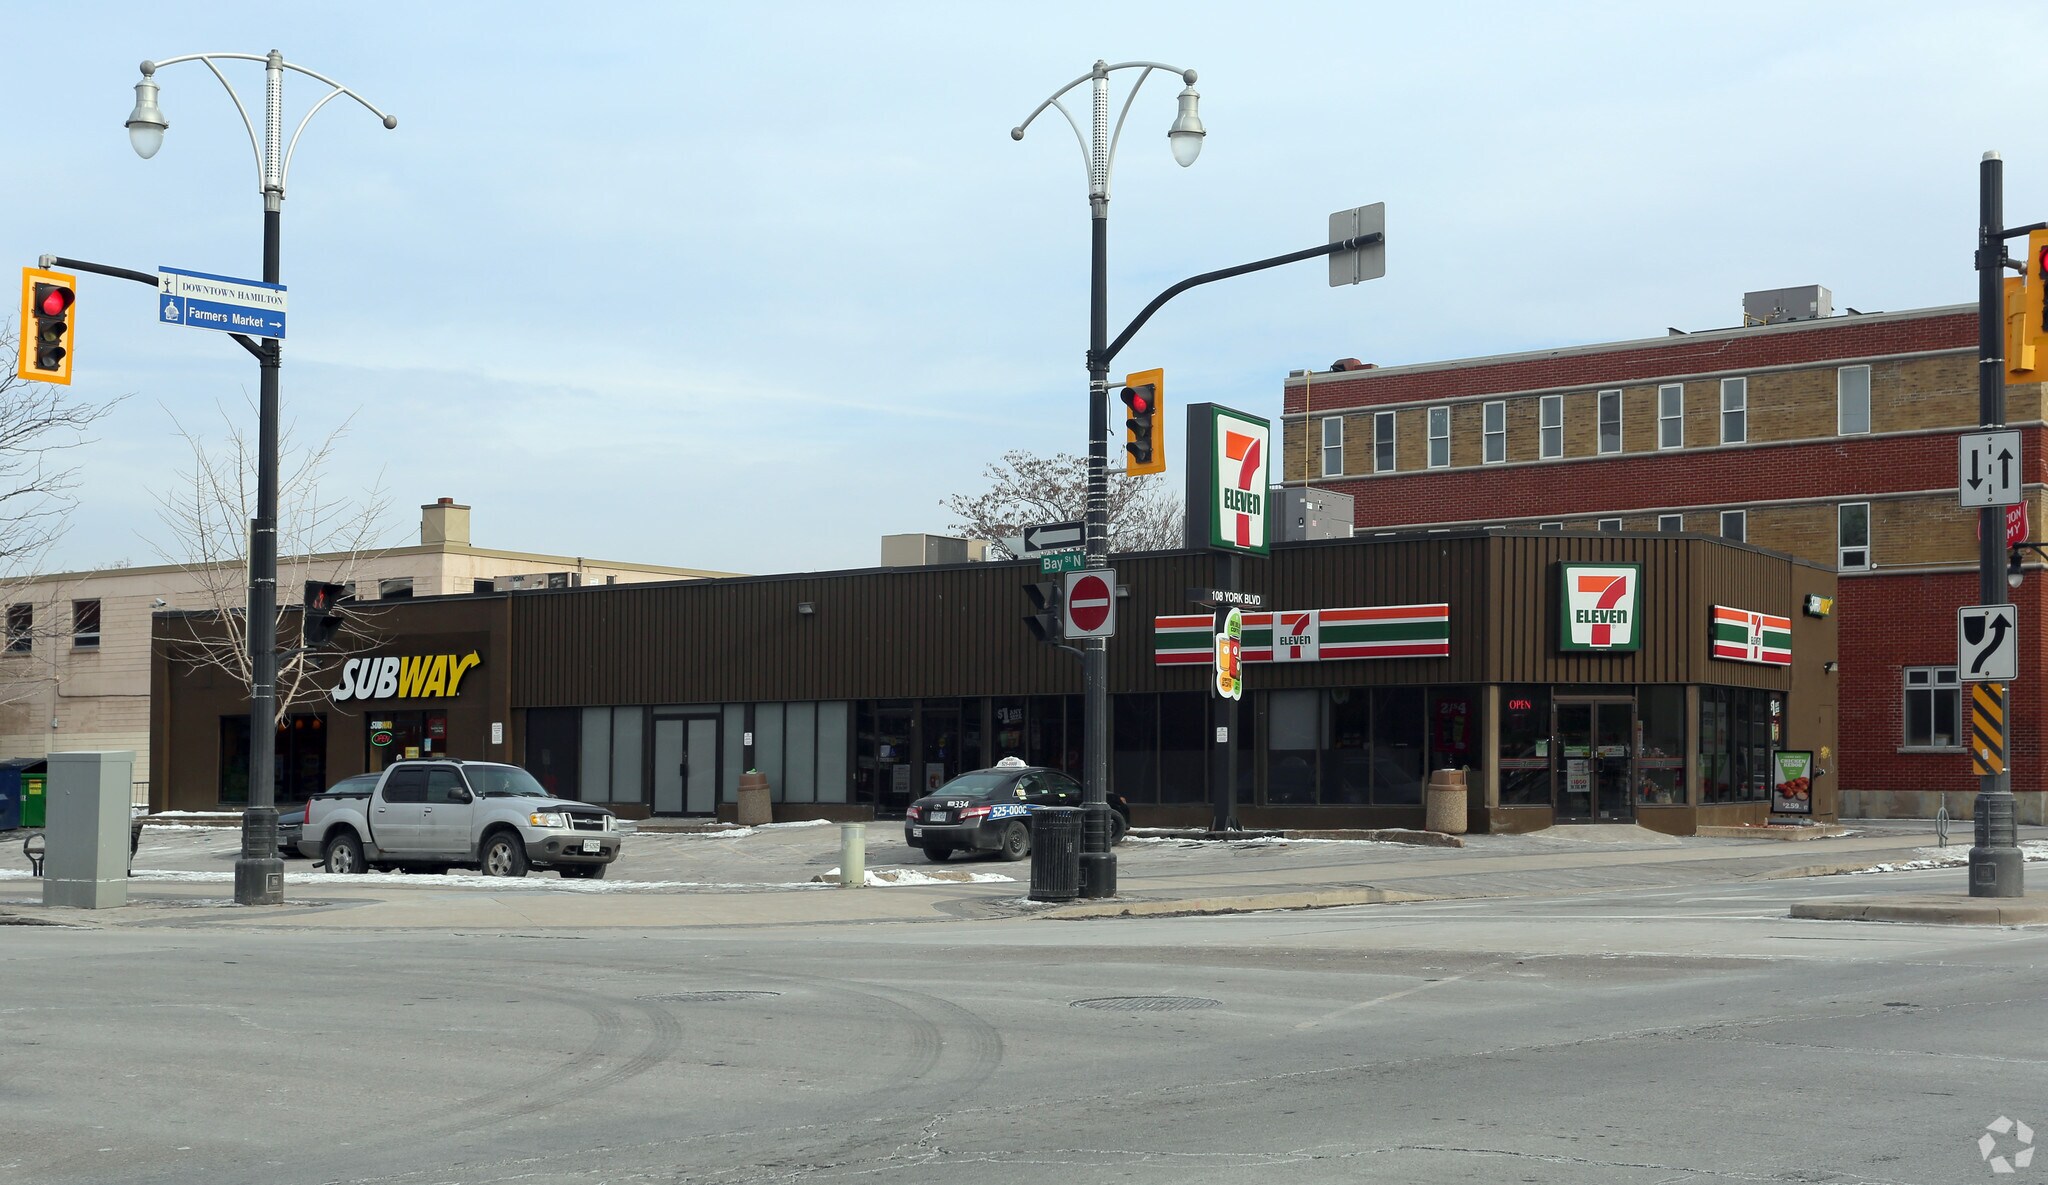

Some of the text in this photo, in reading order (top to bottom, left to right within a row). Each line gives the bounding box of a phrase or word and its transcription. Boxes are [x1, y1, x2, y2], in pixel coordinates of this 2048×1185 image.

[182, 282, 283, 305] DOWNTOWN HAMILTON
[189, 307, 264, 328] Farmers Market
[1043, 557, 1063, 572] Bay
[1073, 554, 1081, 567] N
[1211, 590, 1261, 605] 108 YORK BLVD
[1578, 575, 1627, 645] 7
[1280, 613, 1310, 659] 7
[331, 650, 481, 702] SUBWAY
[1509, 700, 1531, 710] OPEN
[997, 707, 1010, 724] $1
[374, 734, 391, 743] OPEN
[954, 800, 969, 808] 334
